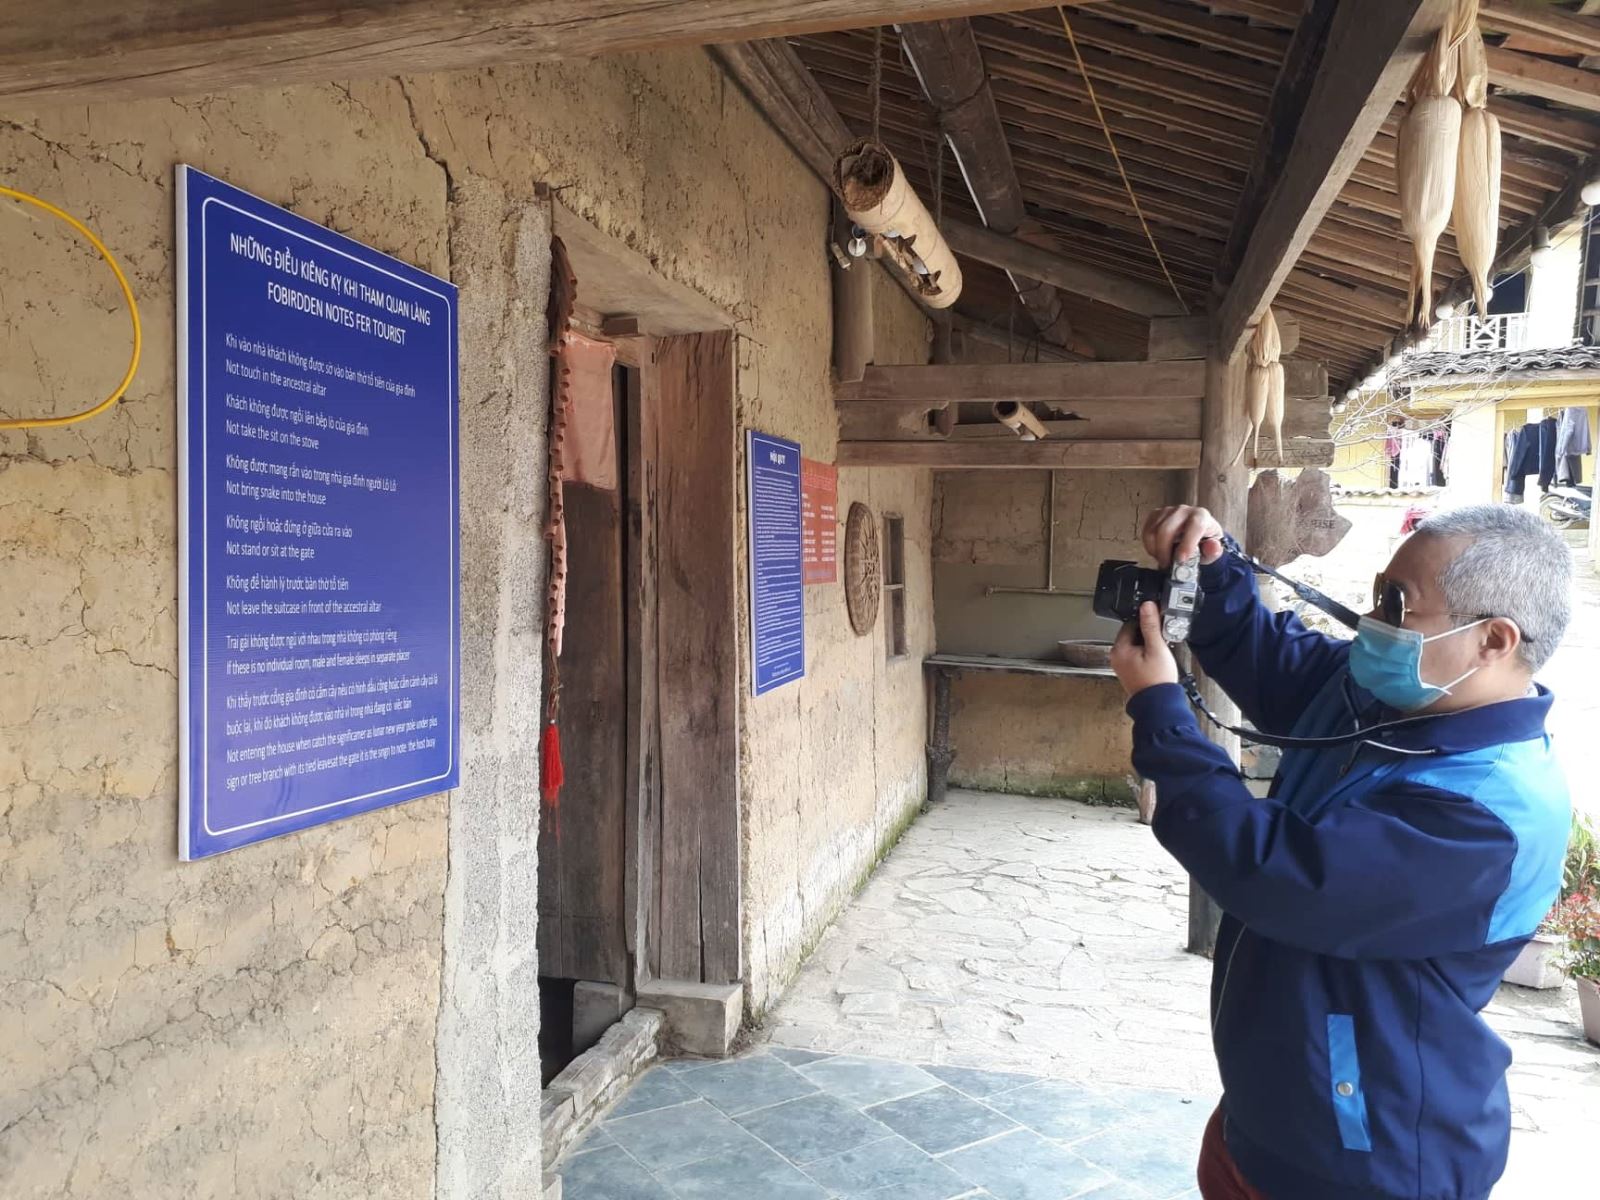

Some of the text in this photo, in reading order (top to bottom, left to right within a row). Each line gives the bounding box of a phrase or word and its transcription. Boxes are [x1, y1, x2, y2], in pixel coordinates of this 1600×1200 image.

[230, 231, 430, 326] NHỮNG ĐIỀU KIÊNG KỴ KHI THAM QUAN LÀNG
[267, 281, 405, 345] FOBIRDDEN NOTES FER TOURIST
[225, 332, 237, 349] Khi
[252, 339, 265, 356] nhà
[267, 344, 286, 362] khách
[287, 350, 307, 371] không
[308, 356, 324, 375] được
[225, 359, 326, 396] Not touch in the ancestral altar
[226, 392, 247, 410] Khách
[248, 398, 270, 418] không
[271, 403, 288, 421] được
[225, 419, 319, 449] Not take the sit on the stove
[226, 454, 248, 474] Không
[249, 458, 268, 476] được
[269, 464, 287, 479] mang
[313, 469, 330, 485] trong
[226, 480, 326, 504] Not bring snake into the house
[226, 514, 248, 533] Không
[334, 527, 341, 536] ra
[226, 541, 314, 561] Not stand or sit at the gate
[226, 575, 248, 592] Không
[250, 573, 259, 589] để
[260, 576, 277, 589] hành
[279, 577, 285, 593] lý
[286, 577, 304, 589] trước
[317, 578, 329, 590] thờ
[329, 575, 336, 590] tổ
[226, 602, 240, 614] Not
[241, 602, 259, 614] leave
[261, 601, 272, 614] the
[273, 601, 299, 613] suitcase
[301, 601, 307, 613] in
[308, 601, 324, 613] front
[324, 601, 332, 612] of
[332, 601, 342, 612] the
[368, 601, 381, 612] altar
[225, 635, 238, 649] Trai
[307, 631, 320, 644] nhau
[226, 660, 231, 675] If
[232, 659, 249, 674] these
[250, 659, 256, 673] is
[256, 662, 265, 672] no
[266, 656, 294, 671] individual
[294, 658, 311, 671] room,
[312, 654, 325, 667] male
[326, 653, 336, 666] and
[226, 695, 236, 709] Khi
[226, 748, 238, 763] Not
[239, 743, 265, 764] entering
[266, 741, 276, 756] the
[277, 738, 295, 754] house
[295, 736, 311, 751] when
[226, 774, 239, 792] sign
[240, 774, 247, 786] or
[248, 771, 262, 784] tree
[262, 765, 283, 781] branch
[283, 762, 296, 776] with
